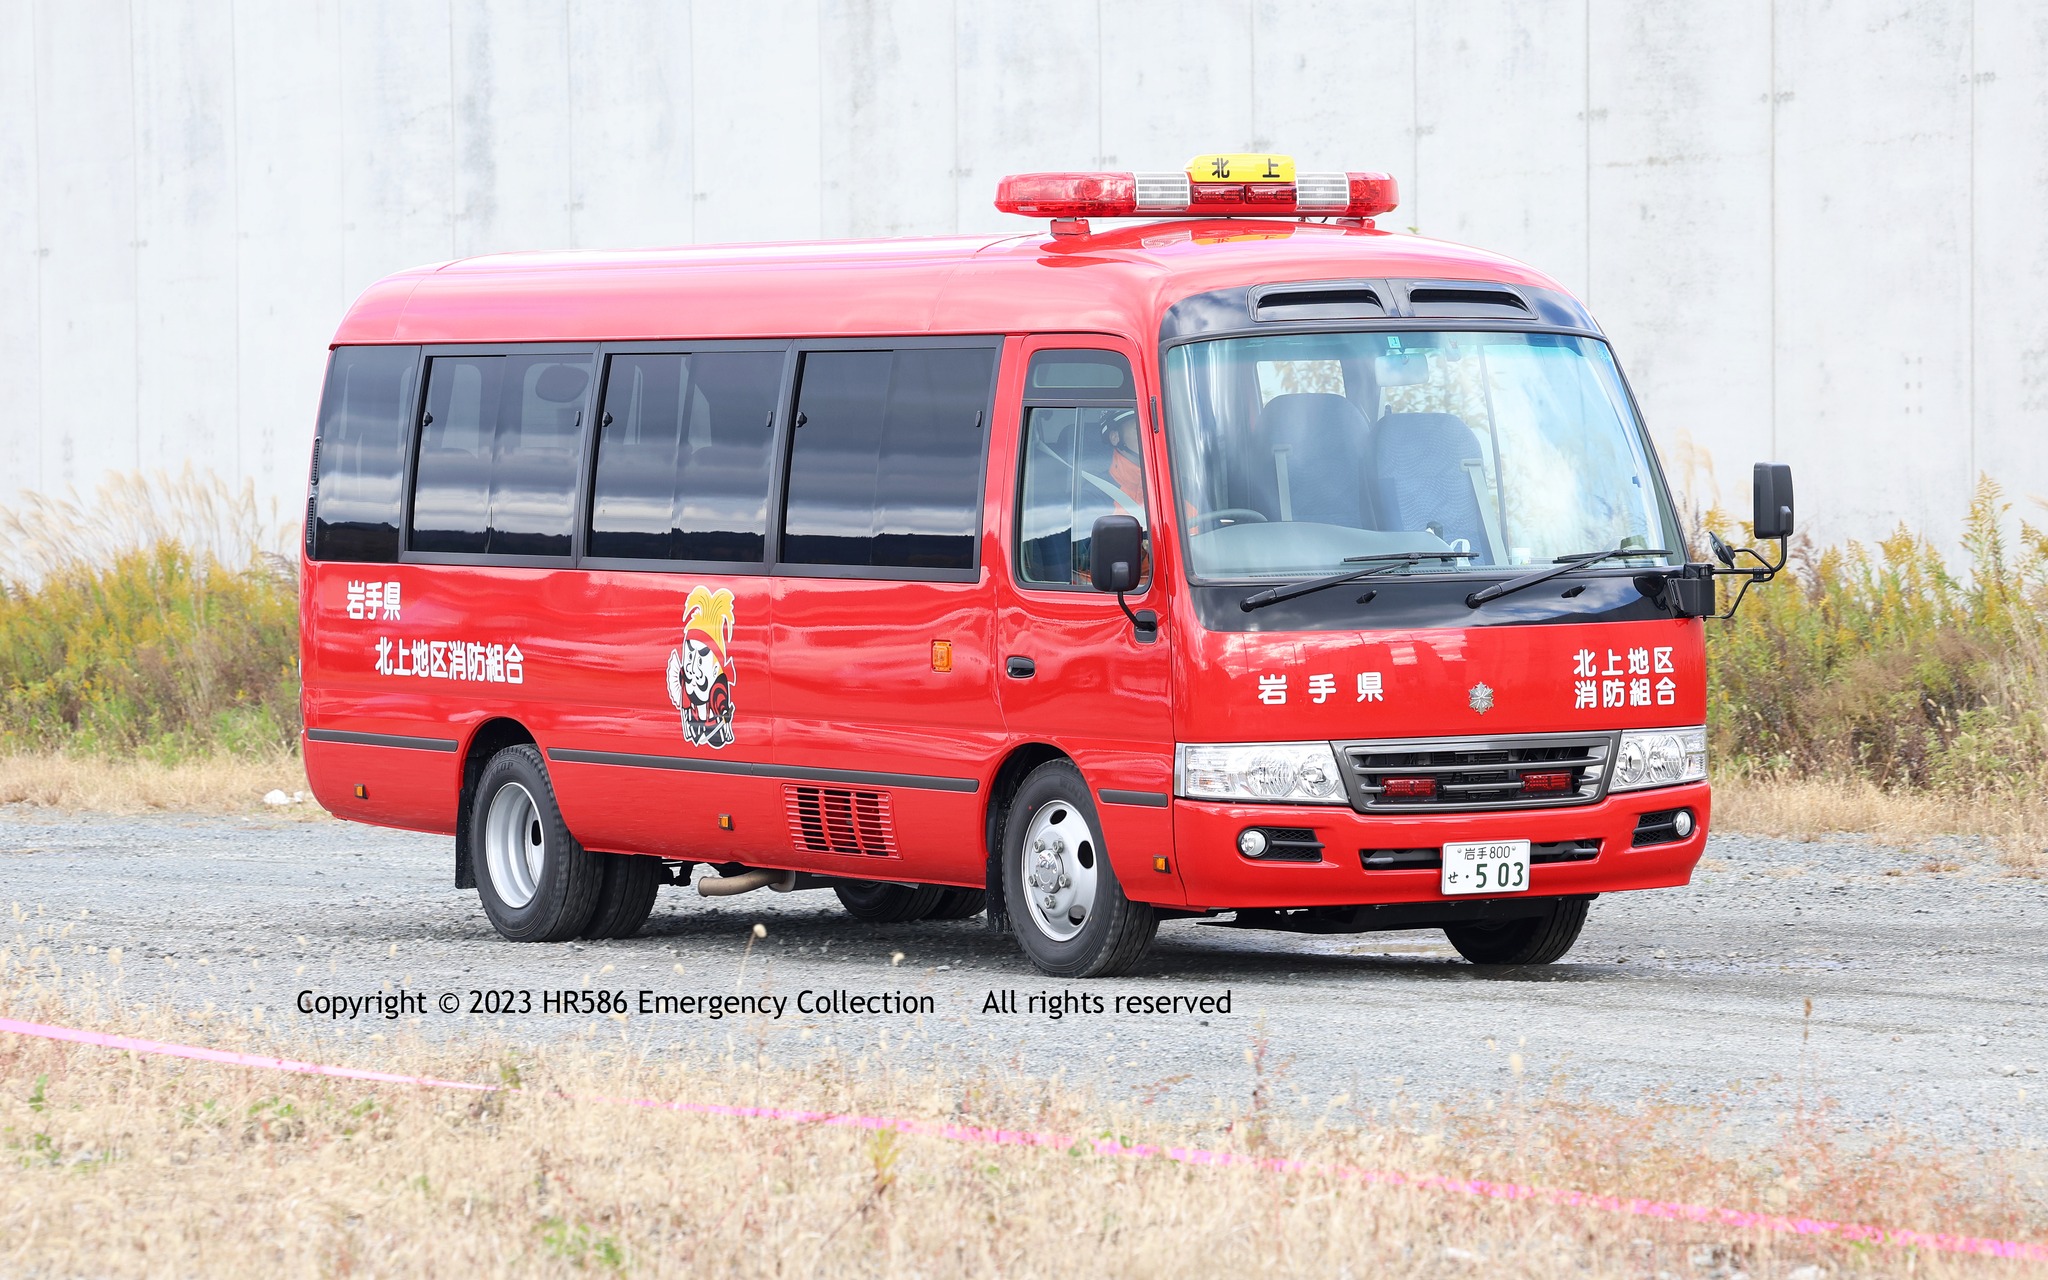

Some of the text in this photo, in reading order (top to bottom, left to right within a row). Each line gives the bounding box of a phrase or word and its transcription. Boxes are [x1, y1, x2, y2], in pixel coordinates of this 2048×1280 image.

[1211, 157, 1280, 179] 北上
[346, 579, 402, 621] 岩手県
[374, 636, 524, 685] 北上地区消防組合
[1572, 646, 1676, 677] 北上地区
[1257, 671, 1384, 706] 岩手県
[1574, 675, 1677, 710] 消防組合
